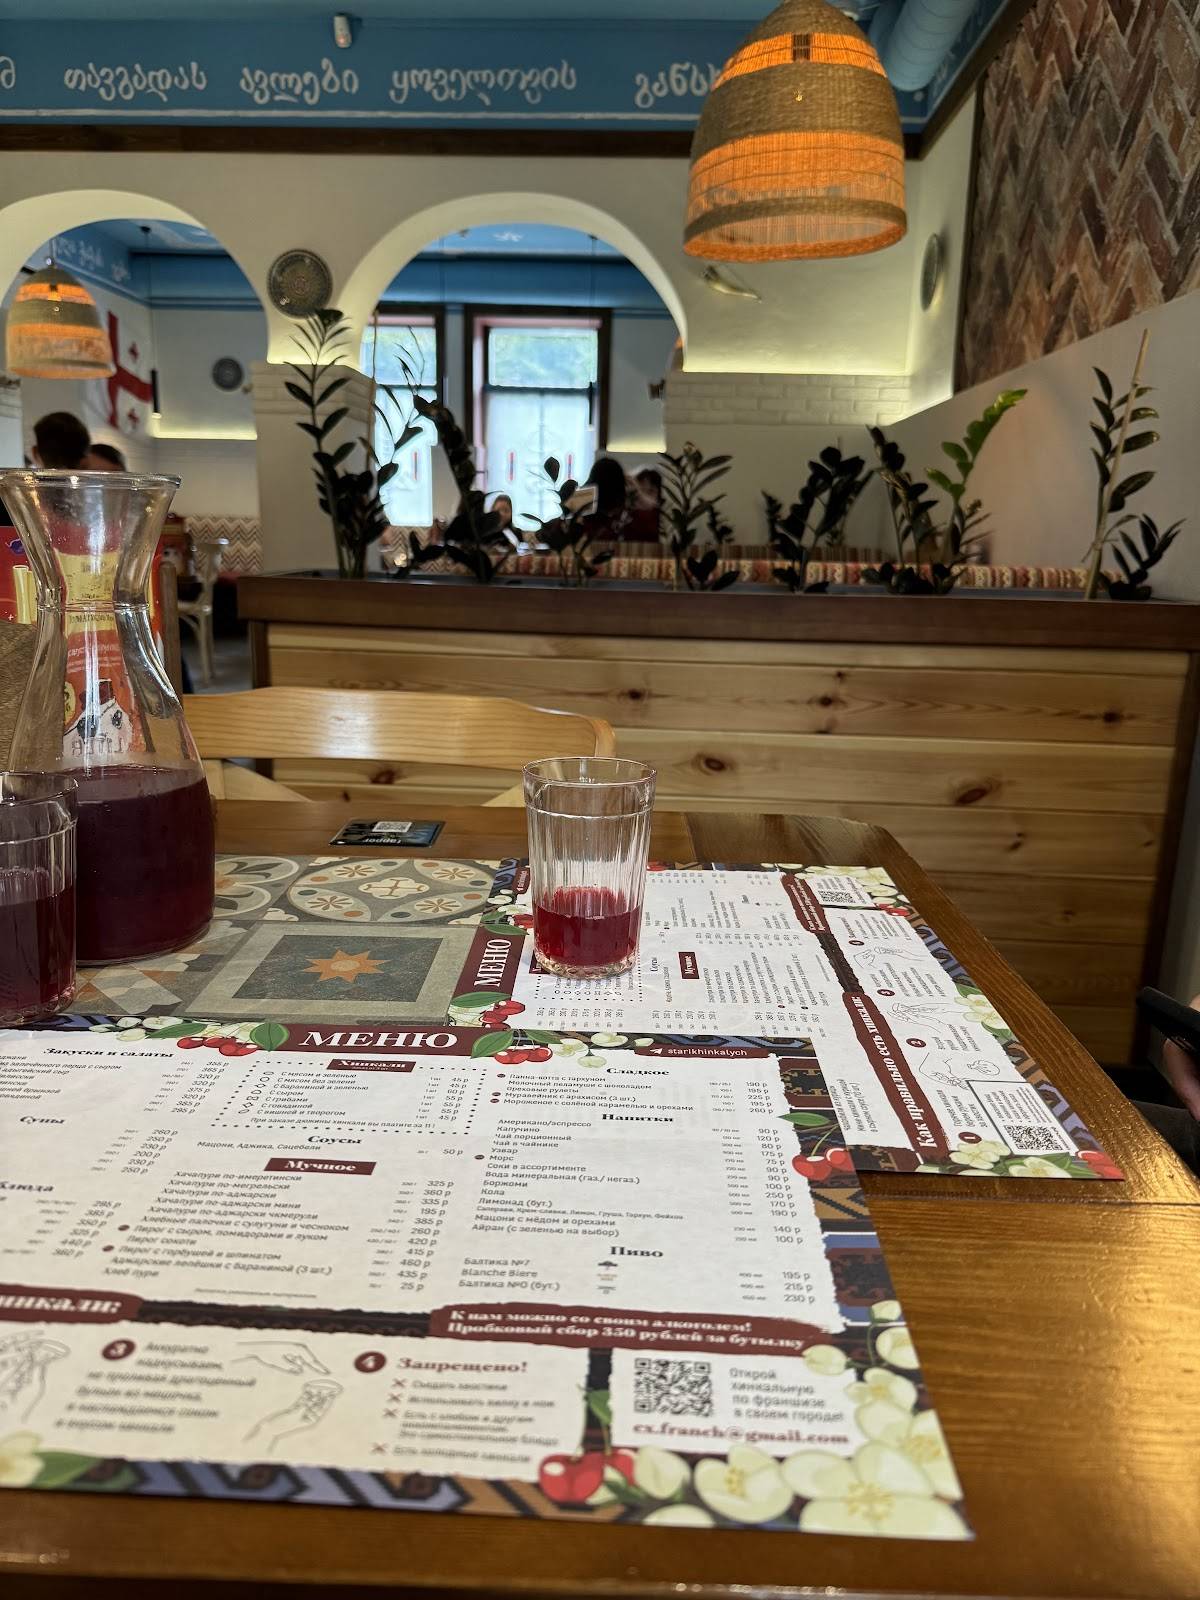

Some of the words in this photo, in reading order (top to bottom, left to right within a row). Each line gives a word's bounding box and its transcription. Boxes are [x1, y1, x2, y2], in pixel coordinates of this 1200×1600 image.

[474, 938, 512, 987] МЕНЮ
[299, 1031, 458, 1049] МЕНЮ
[873, 1036, 890, 1056] есть
[44, 1048, 104, 1057] Закуски
[668, 1048, 747, 1057] starikhinkalych
[338, 1060, 406, 1068] Хинкали
[606, 1068, 670, 1076] Сладкое
[884, 1058, 924, 1120] правильно
[602, 1114, 674, 1122] Напитки
[308, 1135, 362, 1144] Соусы
[916, 1122, 938, 1148] Как
[285, 1160, 356, 1172] Мучное
[520, 1164, 586, 1172] ассортименте
[512, 1173, 577, 1181] минеральная
[483, 1180, 528, 1188] Боржоми
[478, 1197, 524, 1206] Лимонад
[475, 1214, 516, 1223] Мацони
[572, 1218, 616, 1226] орехами
[582, 1228, 620, 1238] выбор)
[610, 1246, 664, 1258] Пиво
[461, 1268, 506, 1277] Blanche
[449, 1309, 464, 1321] К
[570, 1315, 590, 1324] со
[602, 1326, 636, 1338] 350
[397, 1357, 528, 1373] Запрещено!
